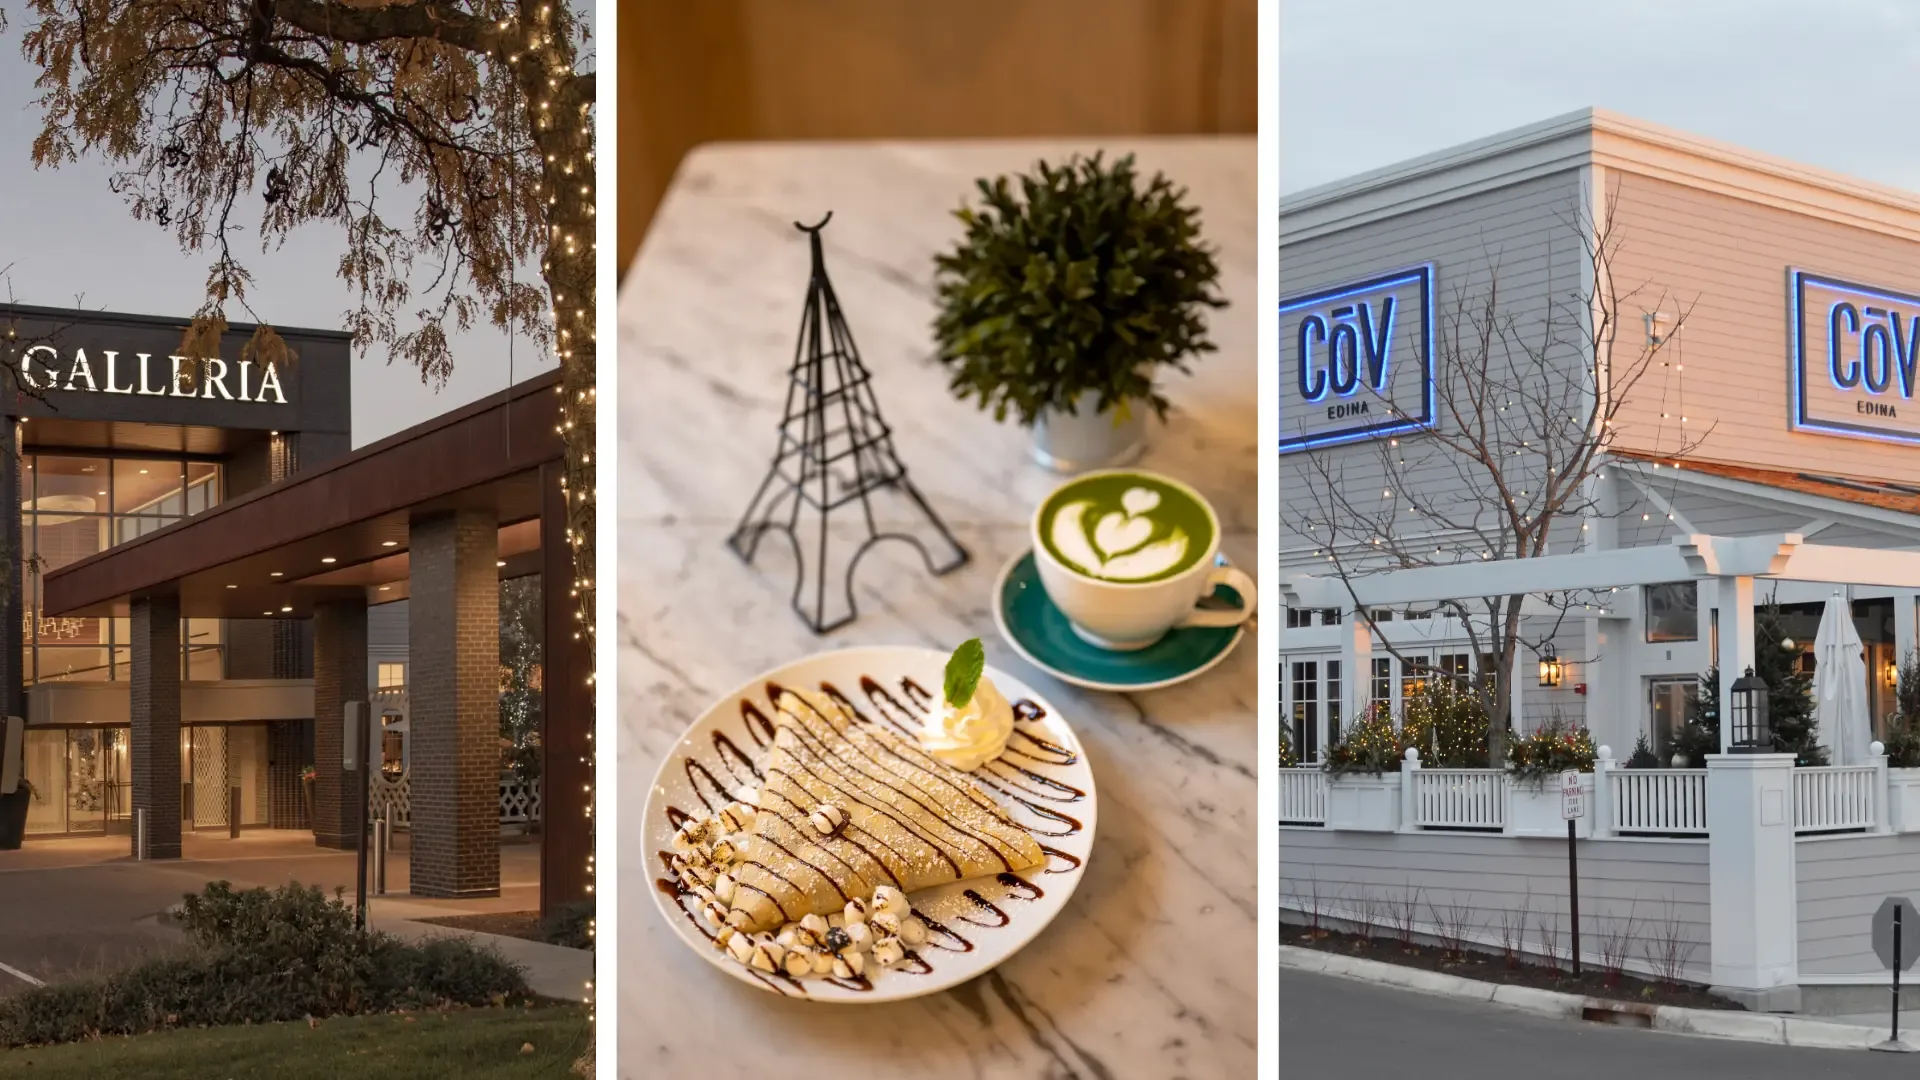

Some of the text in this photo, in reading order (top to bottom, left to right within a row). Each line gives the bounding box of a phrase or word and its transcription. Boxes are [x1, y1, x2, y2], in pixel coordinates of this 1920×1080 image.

[21, 345, 288, 404] GALLERIA
[1327, 401, 1369, 420] EDINA
[1857, 400, 1897, 418] EDINA
[1568, 775, 1578, 786] NO
[1563, 785, 1584, 797] PARKING
